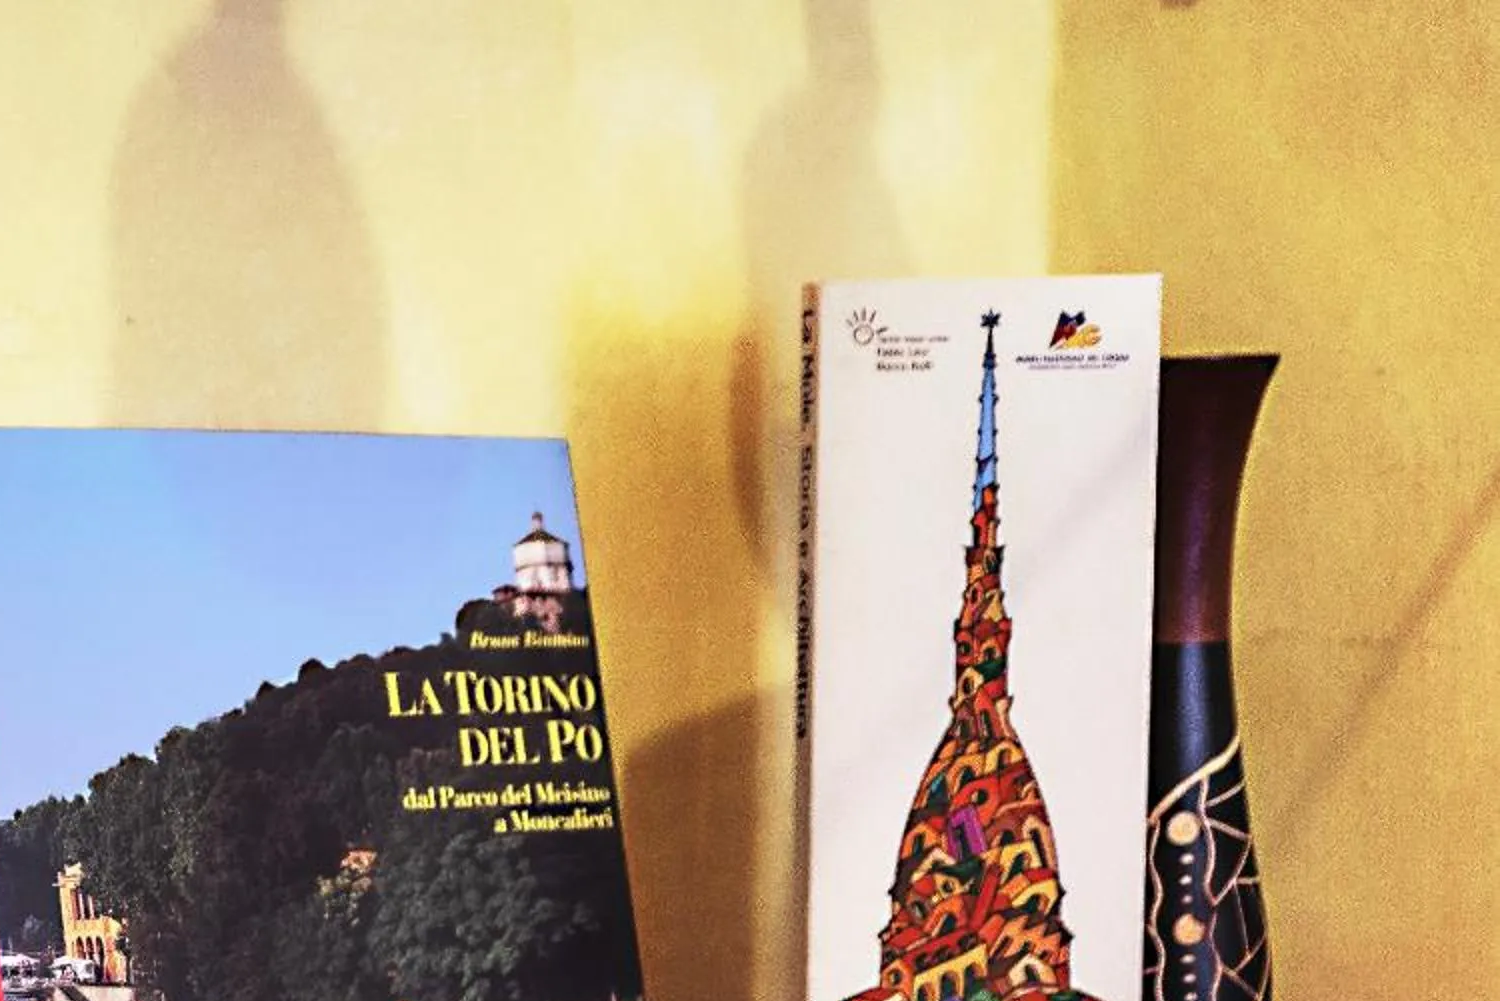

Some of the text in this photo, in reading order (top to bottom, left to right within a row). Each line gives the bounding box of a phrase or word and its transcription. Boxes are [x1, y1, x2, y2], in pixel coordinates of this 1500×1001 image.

[443, 671, 597, 716] TORINO
[458, 727, 541, 767] DEL
[402, 786, 436, 810] dal
[438, 785, 499, 809] Parco
[499, 783, 532, 806] del
[493, 816, 507, 833] a
